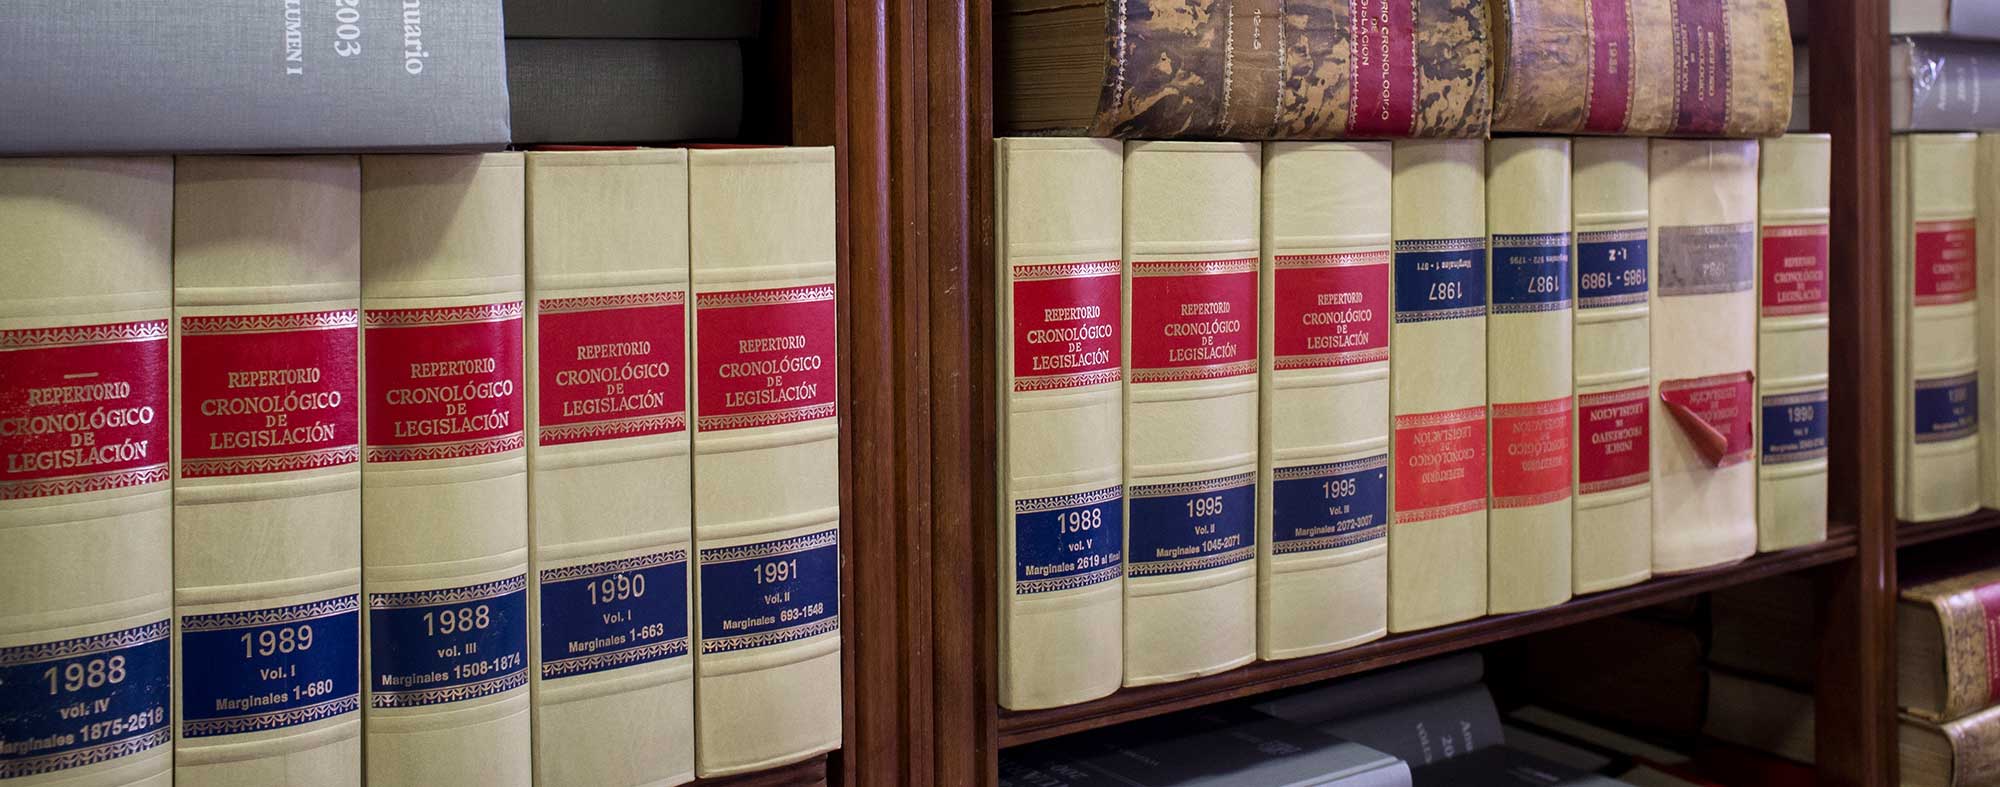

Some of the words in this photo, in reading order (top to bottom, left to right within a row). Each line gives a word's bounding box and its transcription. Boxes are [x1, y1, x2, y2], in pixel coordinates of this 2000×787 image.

[1381, 26, 1390, 120] CRONOLOGICO
[1528, 274, 1559, 293] 1987
[1582, 272, 1613, 290] 1989
[1623, 269, 1646, 287] 1985
[1317, 291, 1363, 306] REPERTORIO
[1429, 281, 1462, 300] 1987
[1044, 305, 1101, 322] REPERTORIO
[1181, 301, 1231, 316] REPERTORIO
[1302, 308, 1372, 326] CRONOLÓGICO
[1026, 324, 1113, 344] CRONOLÓGICO
[1164, 318, 1240, 337] CRONOLÓGICO
[1336, 324, 1348, 334] DE
[739, 335, 806, 354] REPERTORIO
[1068, 342, 1082, 353] DE
[1201, 336, 1214, 346] DE
[1307, 330, 1369, 350] LEGISLACIÓN
[576, 341, 651, 360] REPERTORIO
[1032, 347, 1110, 371] LEGISLACIÓN
[1169, 341, 1237, 362] LEGISLACIÓN
[410, 357, 496, 379] REPERTORIO
[555, 362, 670, 386] CRONOLÓGICO
[719, 355, 822, 378] CRONOLÓGICO
[227, 367, 321, 388] REPERTORIO
[767, 376, 782, 387] DE
[27, 381, 130, 406] REPERTORIO
[386, 379, 513, 405] CRONOLÓGICO
[607, 383, 624, 395] DE
[725, 381, 818, 408] LEGISLACIÓN
[200, 390, 341, 416] CRONOLÓGICO
[446, 403, 467, 416] DE
[563, 389, 664, 417] LEGISLACIÓN
[0, 406, 154, 436] CRONOLÓGICO
[266, 414, 288, 428] DE
[394, 408, 509, 438] LEGISLACIÓN
[70, 433, 95, 447] DE
[209, 421, 335, 450] LEGISLACIÓN
[7, 438, 148, 473] LEGISLACIÓN
[1322, 477, 1356, 499] 1995
[1186, 495, 1223, 518] 1995
[1057, 507, 1101, 534] 1988
[1194, 526, 1209, 536] Vol.
[1210, 523, 1215, 533] II
[1295, 525, 1335, 538] Marginales
[1068, 541, 1085, 552] vol.
[1086, 538, 1093, 549] V
[1156, 545, 1200, 558] Marginales
[753, 559, 797, 585] 1991
[1025, 562, 1075, 576] Marginales
[1077, 554, 1100, 570] 2619
[587, 573, 645, 605] 1990
[764, 592, 783, 605] Vol.
[784, 592, 791, 602] II
[423, 604, 490, 637] 1988
[603, 612, 625, 625] Vol.
[627, 609, 632, 621] I
[723, 615, 776, 631] Marginales
[240, 624, 313, 658] 1989
[568, 634, 626, 653] Marginales
[629, 622, 664, 642] 1-663
[438, 645, 461, 658] vol.
[465, 642, 477, 654] III
[43, 655, 126, 695] 1988
[260, 666, 287, 681] Vol.
[290, 664, 296, 677] I
[381, 671, 449, 687] Marginales
[453, 652, 521, 680] 1508-1874
[215, 692, 289, 711] Marginales
[292, 678, 333, 700] 1-680
[60, 703, 90, 720] vol.
[94, 698, 110, 713] IV
[80, 706, 164, 742] 1875-2618
